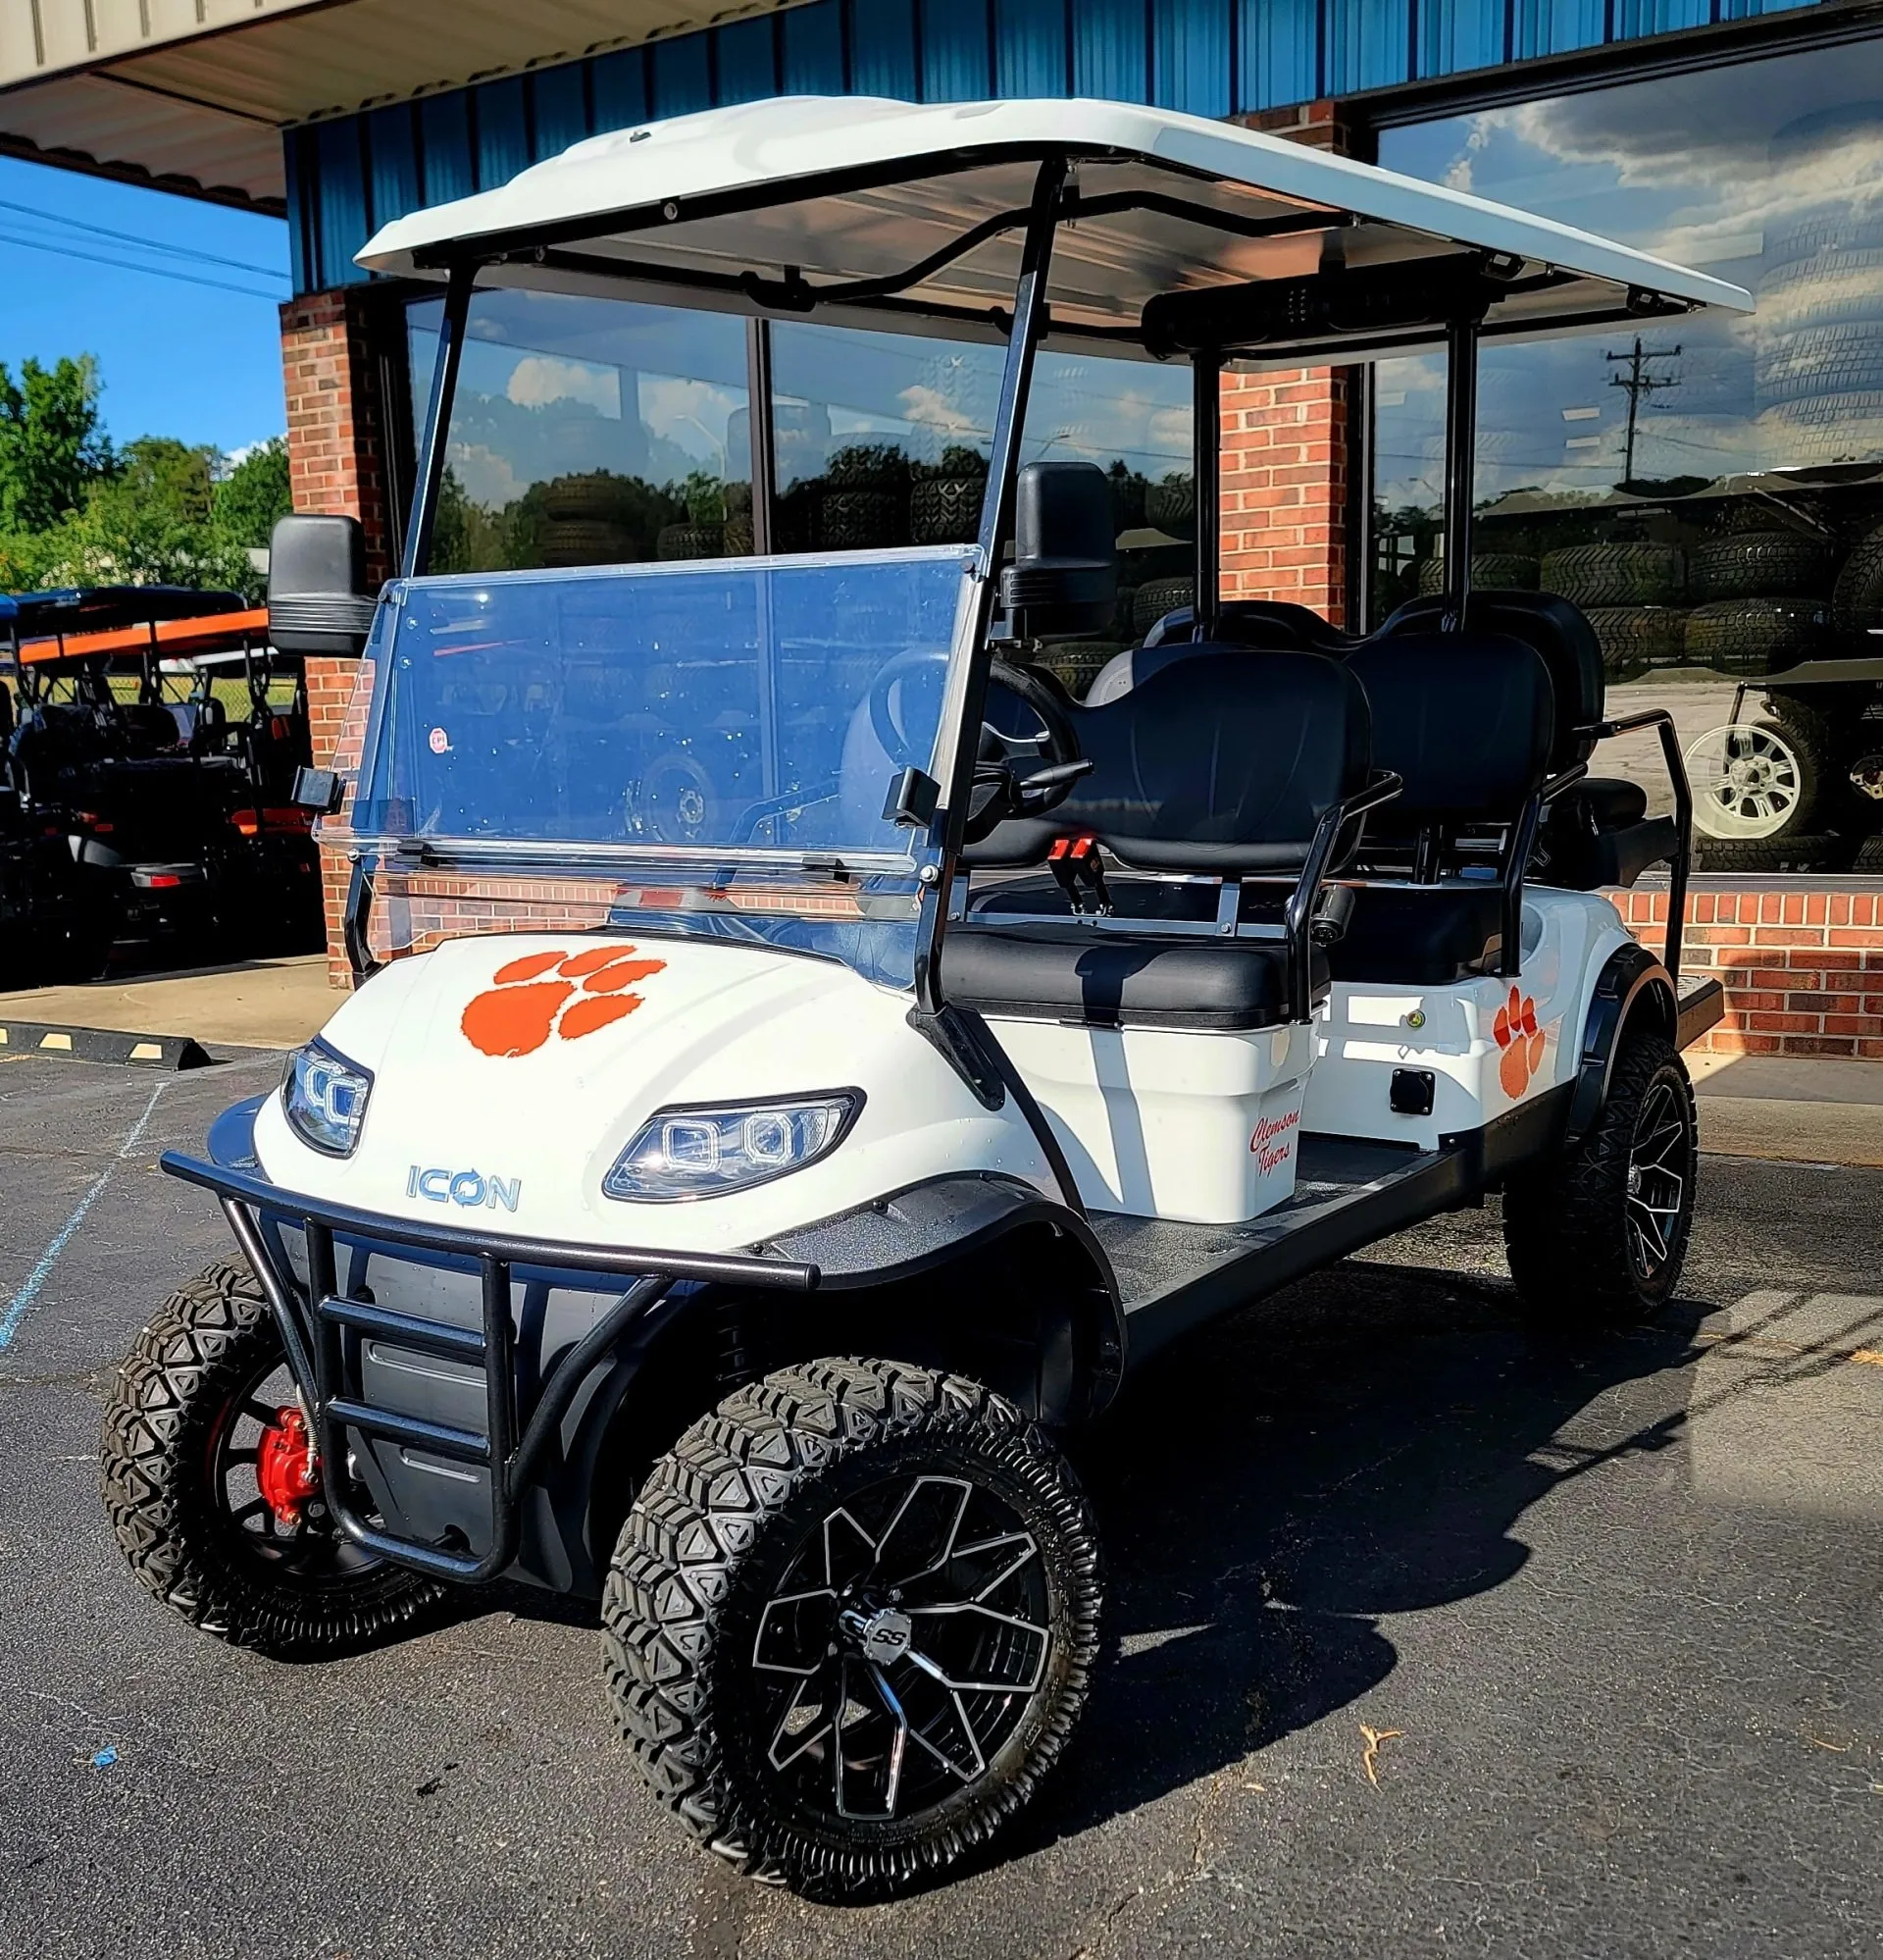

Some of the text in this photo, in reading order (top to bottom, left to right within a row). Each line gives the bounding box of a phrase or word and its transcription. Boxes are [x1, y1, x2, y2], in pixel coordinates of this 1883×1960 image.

[1249, 1109, 1300, 1153] Clemson
[1258, 1141, 1291, 1178] Tigers
[406, 1164, 522, 1213] ICON
[871, 1628, 907, 1646] SS
